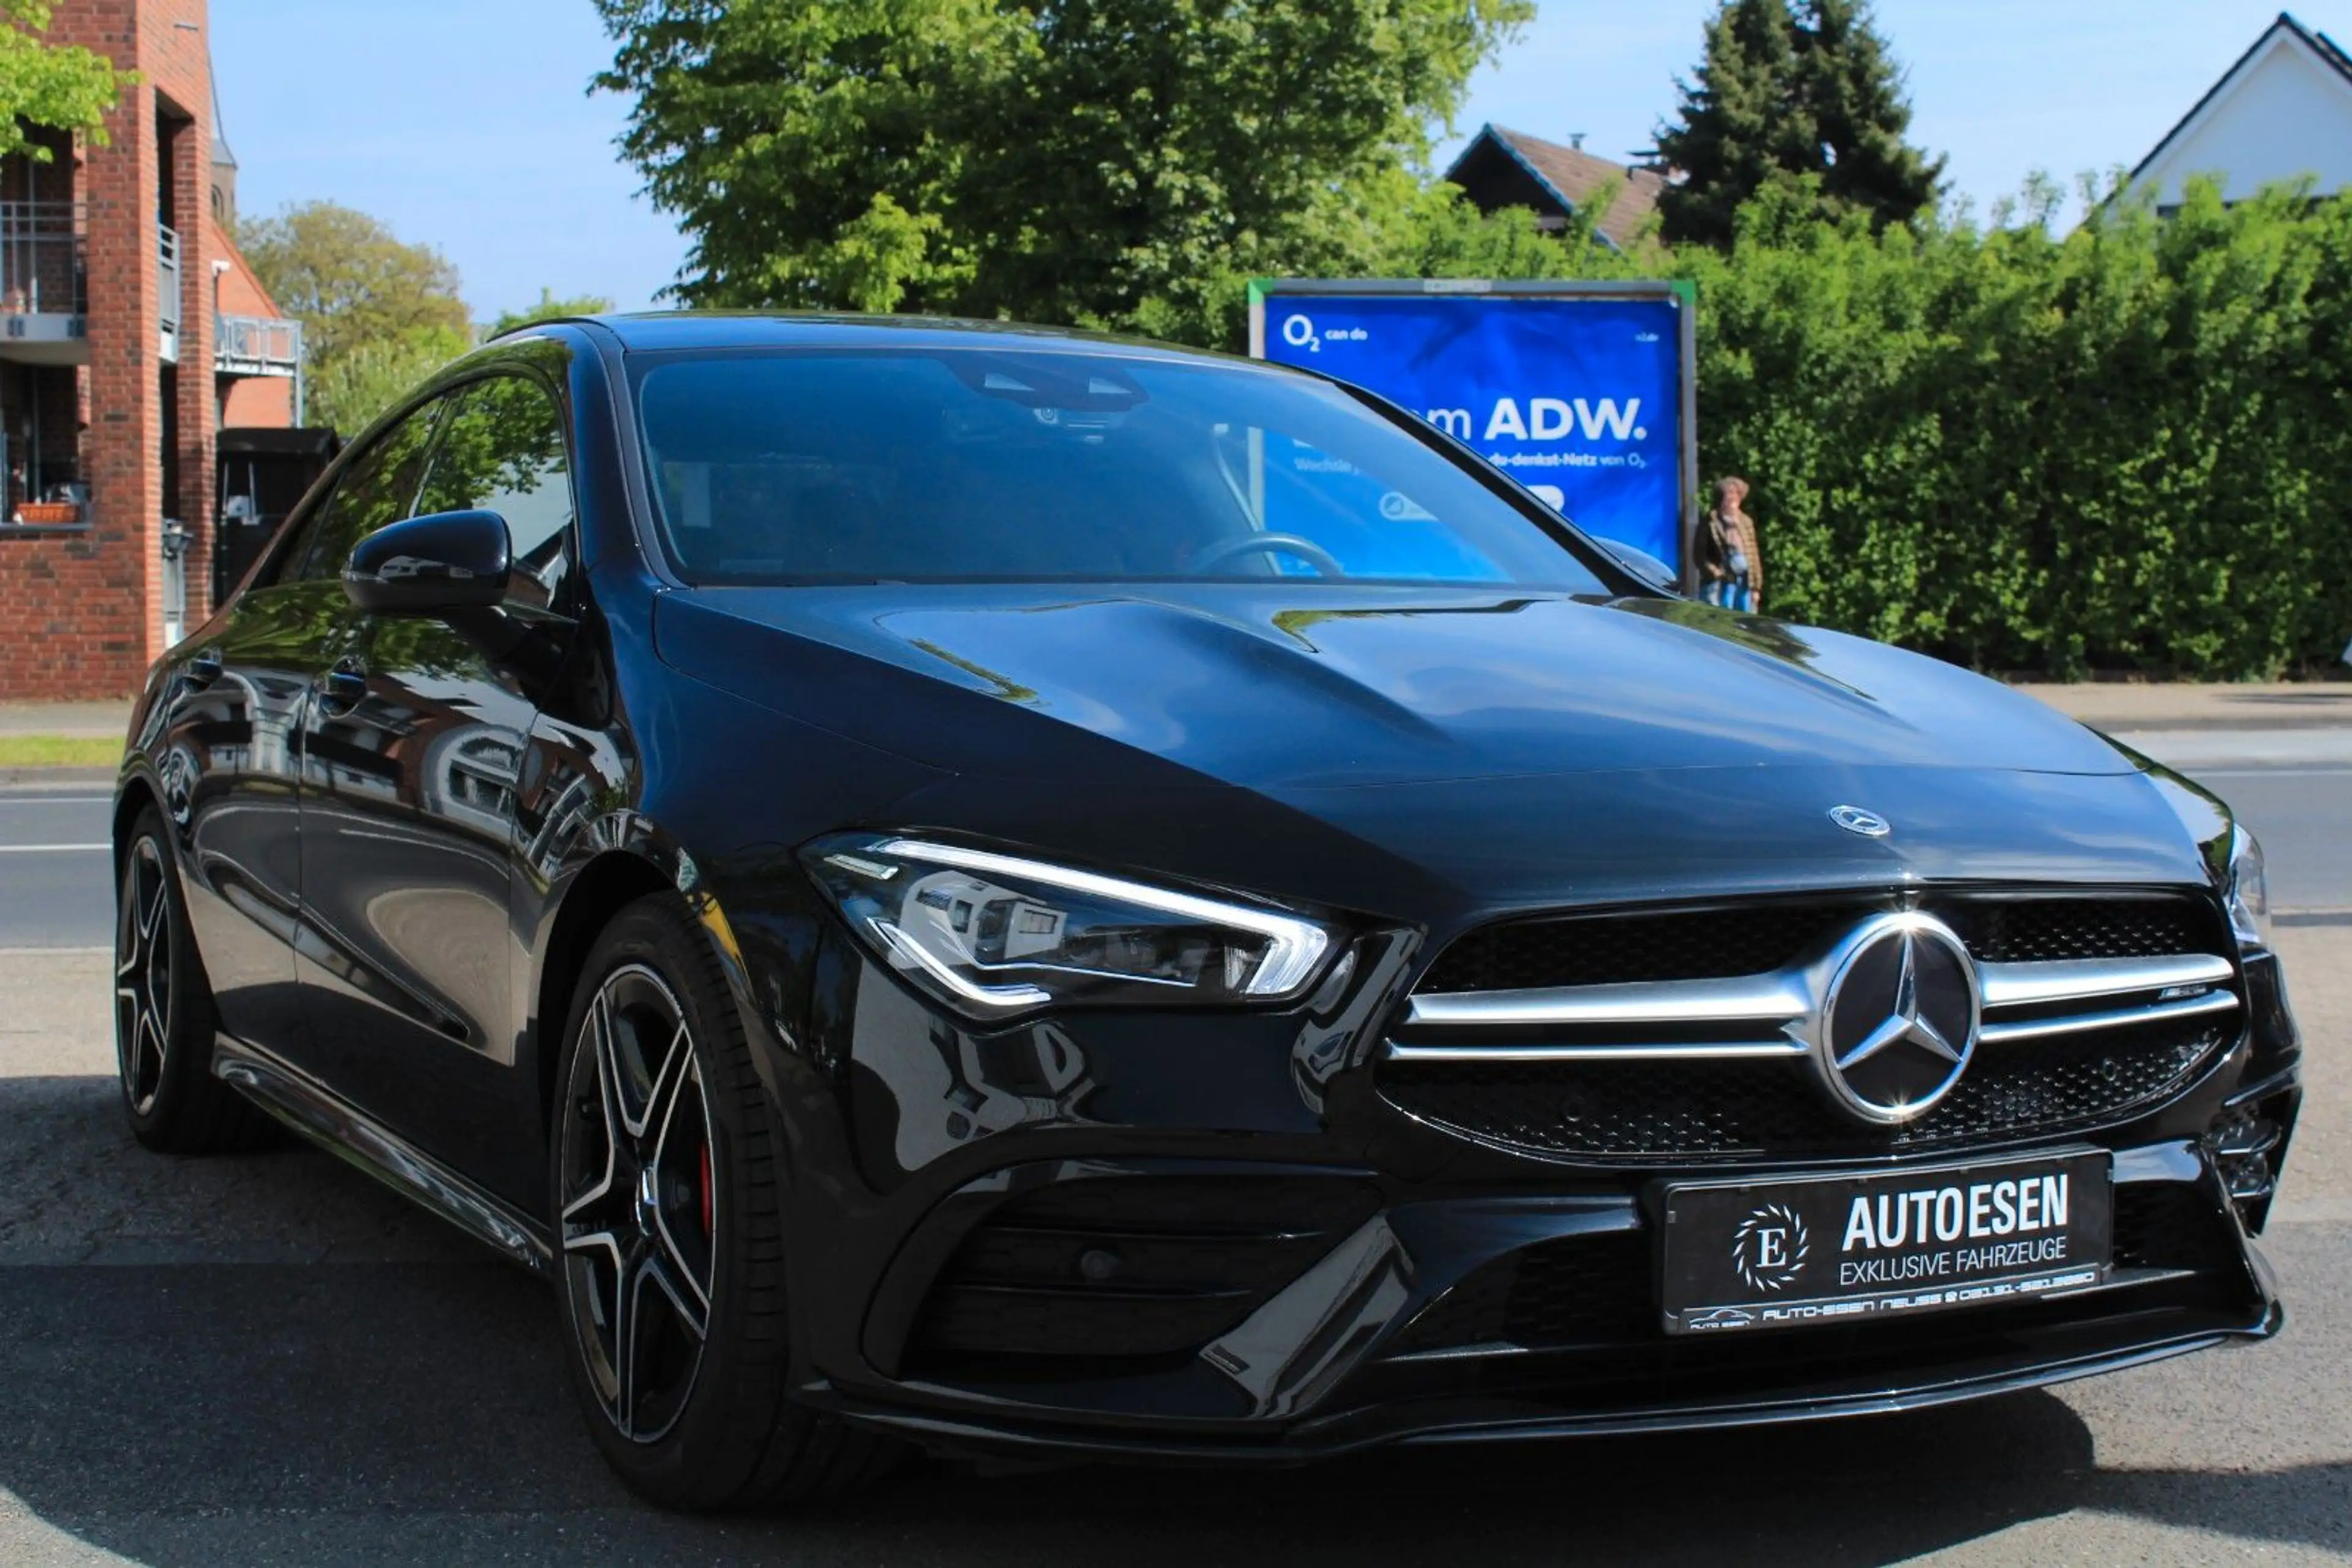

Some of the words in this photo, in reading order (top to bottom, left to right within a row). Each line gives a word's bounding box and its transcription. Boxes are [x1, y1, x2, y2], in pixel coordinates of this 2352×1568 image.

[1325, 329, 1348, 340] can
[1349, 326, 1368, 340] do
[1483, 398, 1648, 440] ADW.
[1600, 456, 1625, 466] von
[1755, 1228, 1786, 1268] E
[1840, 1251, 1950, 1286] EXKLUSIVE
[1956, 1236, 2067, 1272] FAHRZEUGE
[1880, 1293, 1942, 1310] NEUSS
